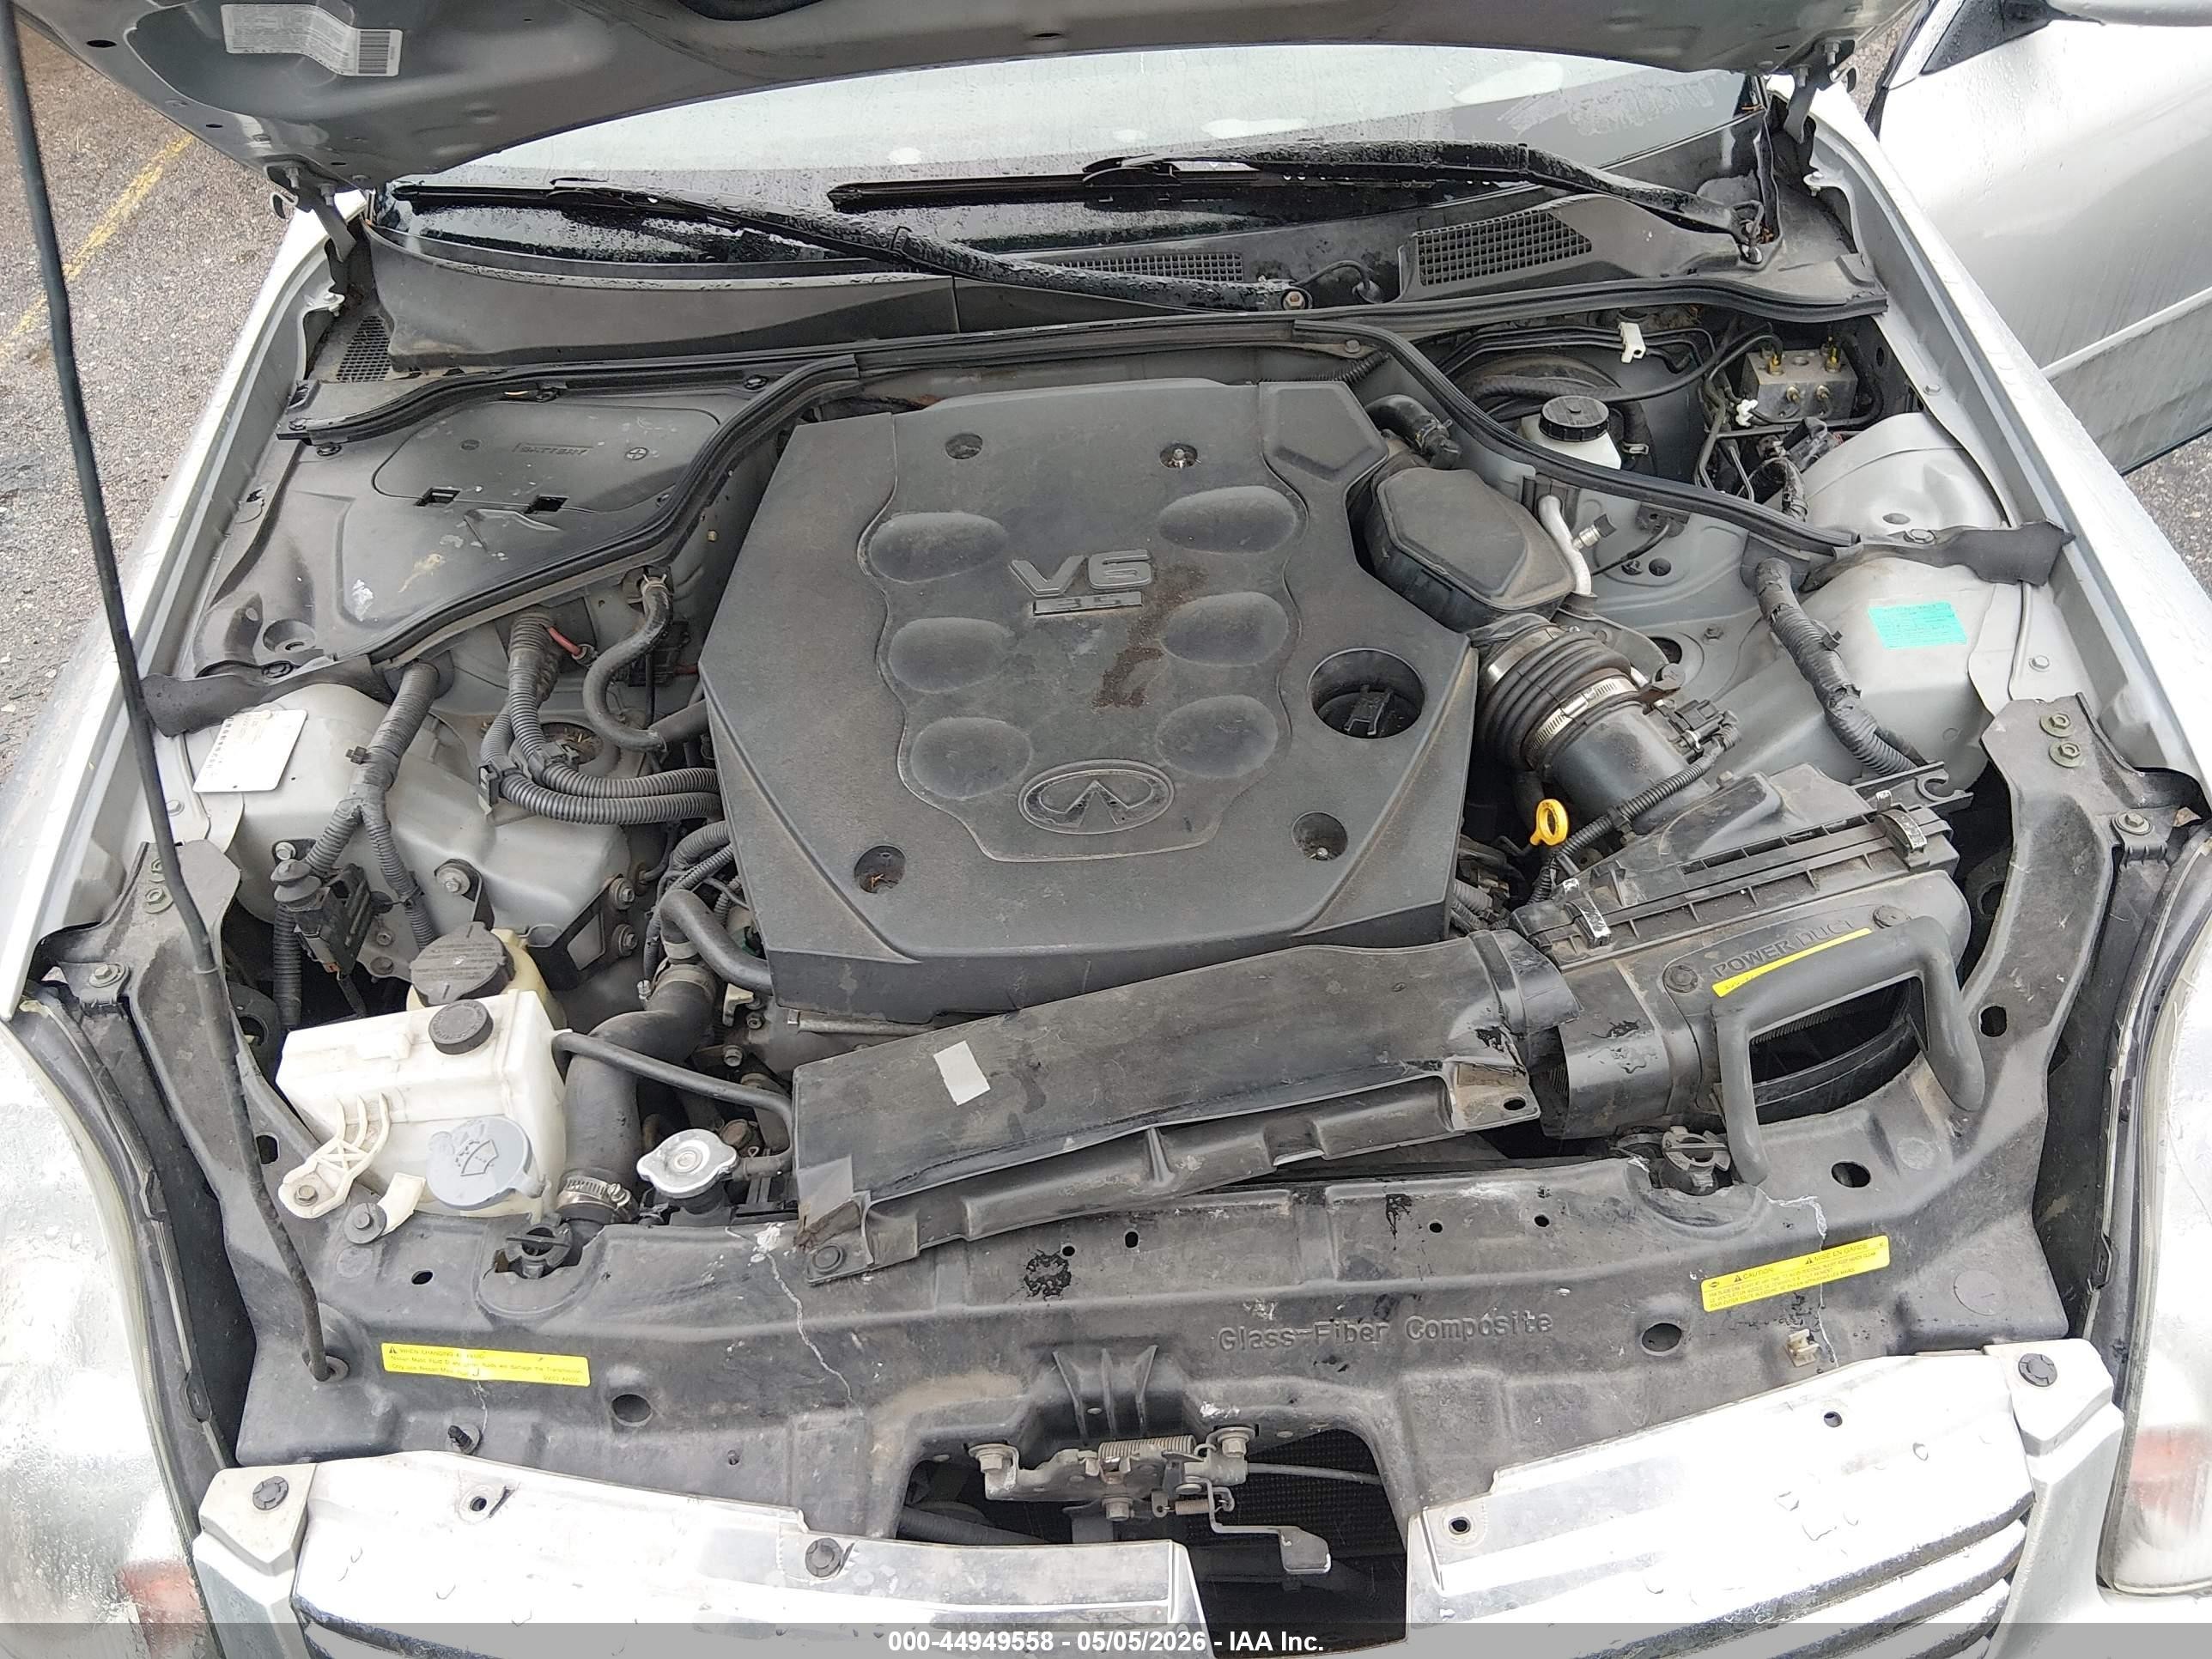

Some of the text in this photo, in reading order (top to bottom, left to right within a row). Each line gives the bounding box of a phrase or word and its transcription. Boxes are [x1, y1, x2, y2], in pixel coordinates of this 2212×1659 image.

[1008, 549, 1152, 598] V6
[1711, 939, 1795, 978] POWER
[1742, 1267, 1774, 1280] CAUTION
[1216, 1310, 1553, 1352] Glass-Fiber Composite
